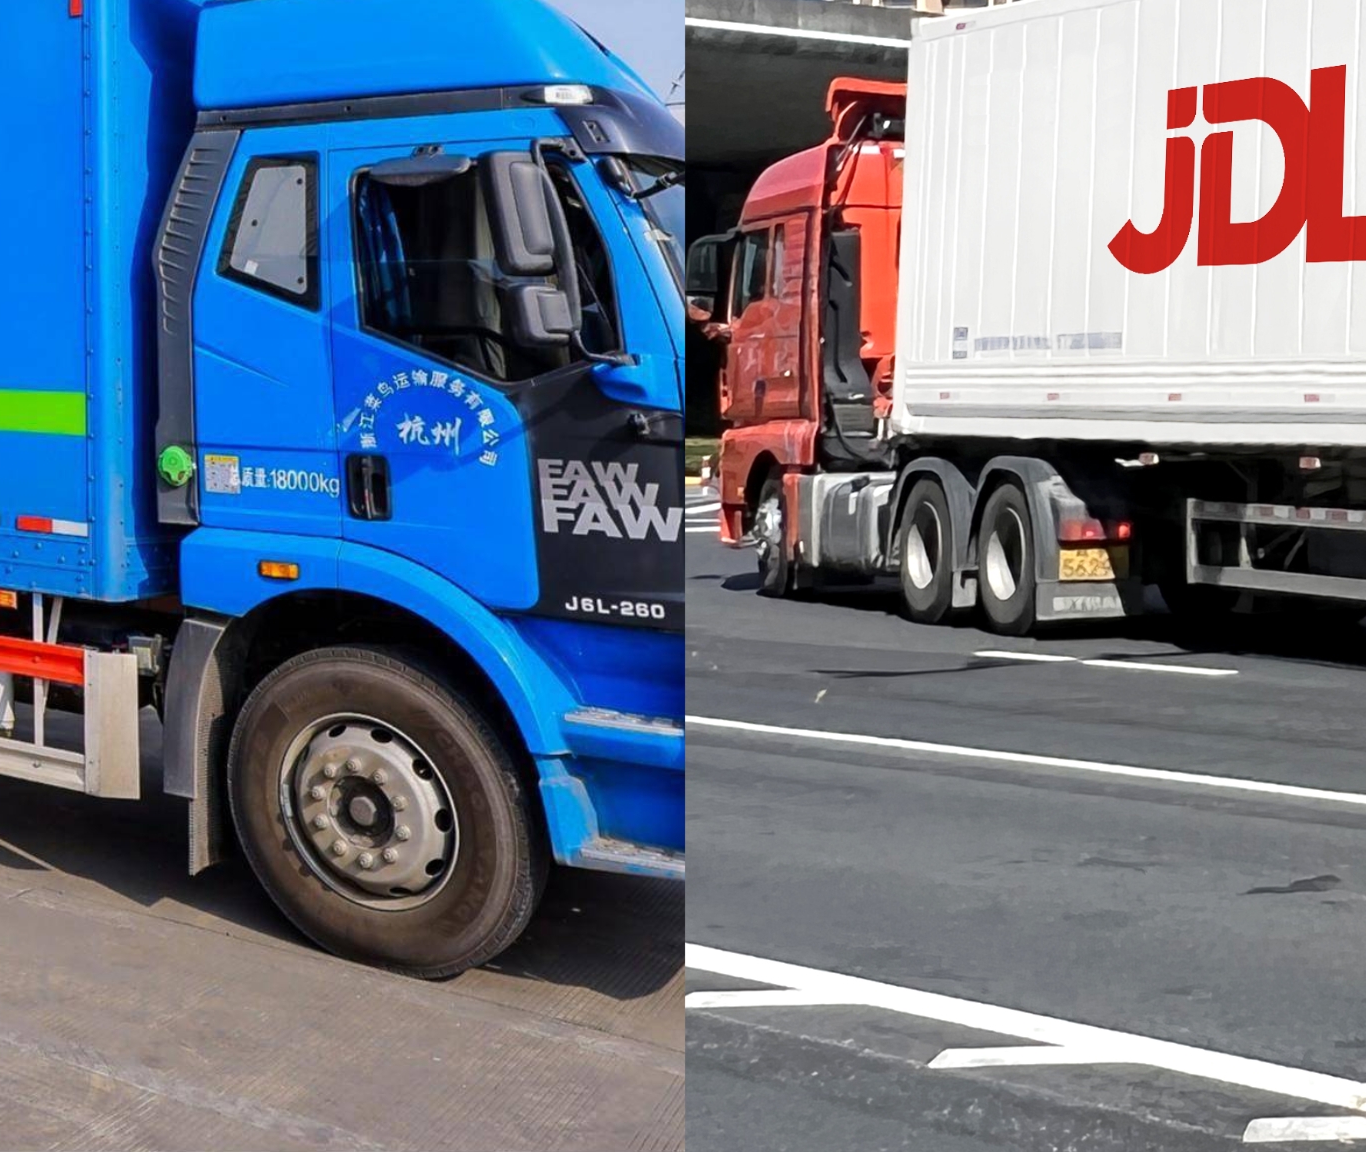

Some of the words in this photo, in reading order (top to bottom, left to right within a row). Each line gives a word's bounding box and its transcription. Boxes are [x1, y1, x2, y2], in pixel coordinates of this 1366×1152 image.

[395, 411, 462, 456] 杭州
[537, 458, 639, 483] FAW
[540, 478, 660, 508] FAW
[541, 499, 684, 542] FAW
[565, 596, 666, 619] J6L-260
